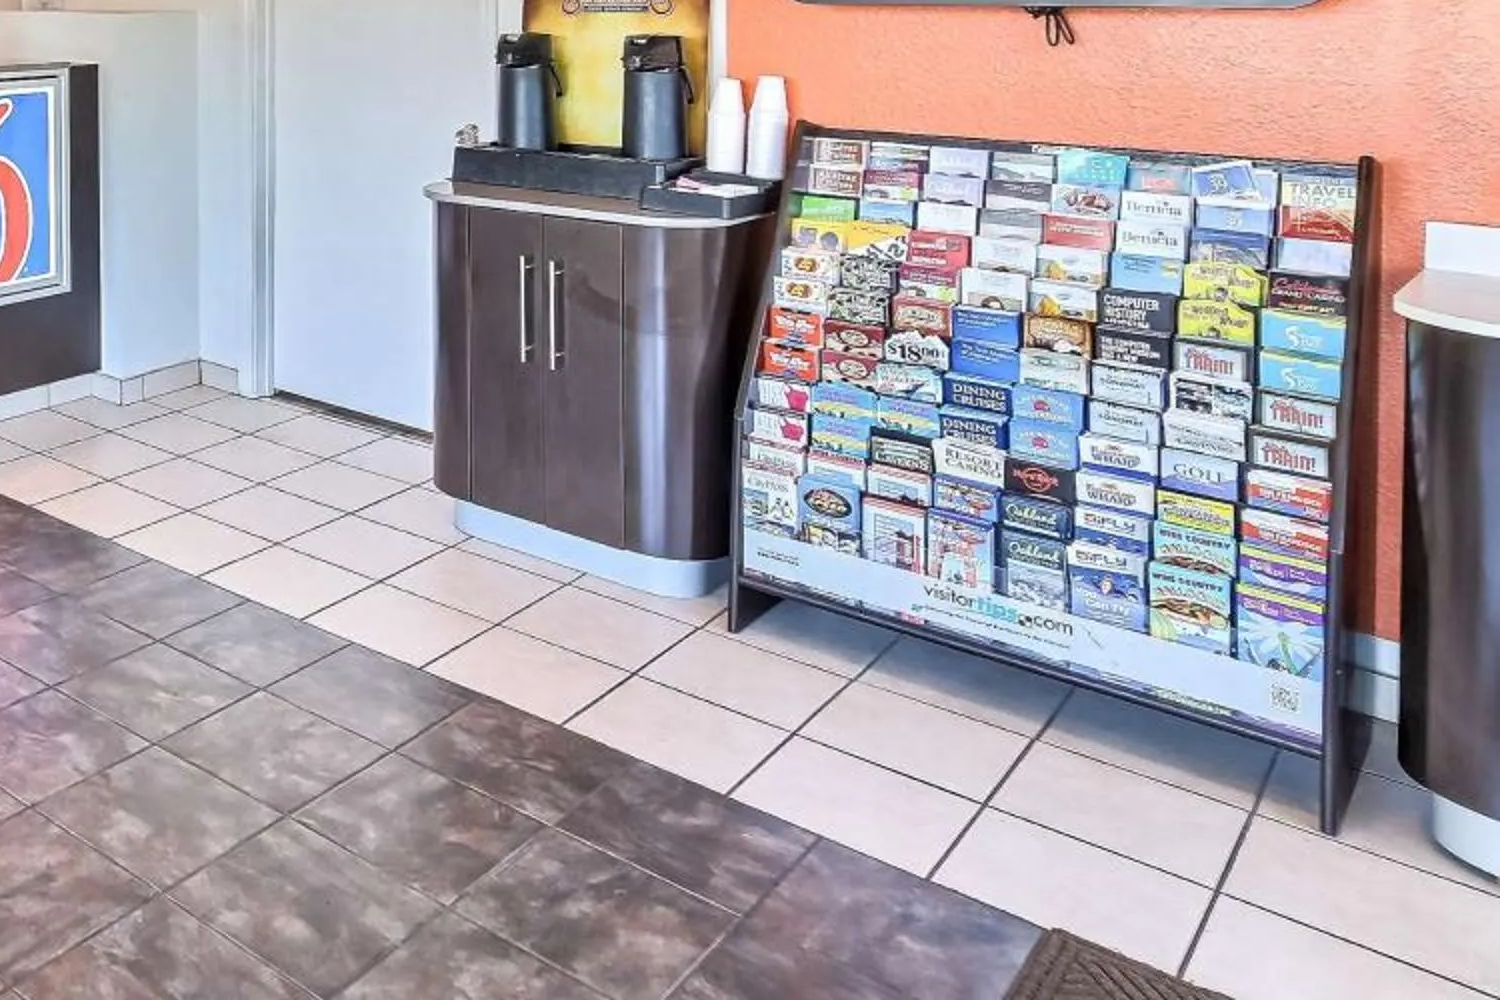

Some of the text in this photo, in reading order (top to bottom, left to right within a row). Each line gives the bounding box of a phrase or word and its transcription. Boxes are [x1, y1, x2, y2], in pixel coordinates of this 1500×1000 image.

[1289, 184, 1357, 199] TRAVEL
[1103, 294, 1160, 311] COMPUTER
[1103, 306, 1148, 321] HISTORY
[953, 383, 1006, 401] DINING
[953, 393, 1007, 412] CRUISES
[943, 417, 997, 435] DINING
